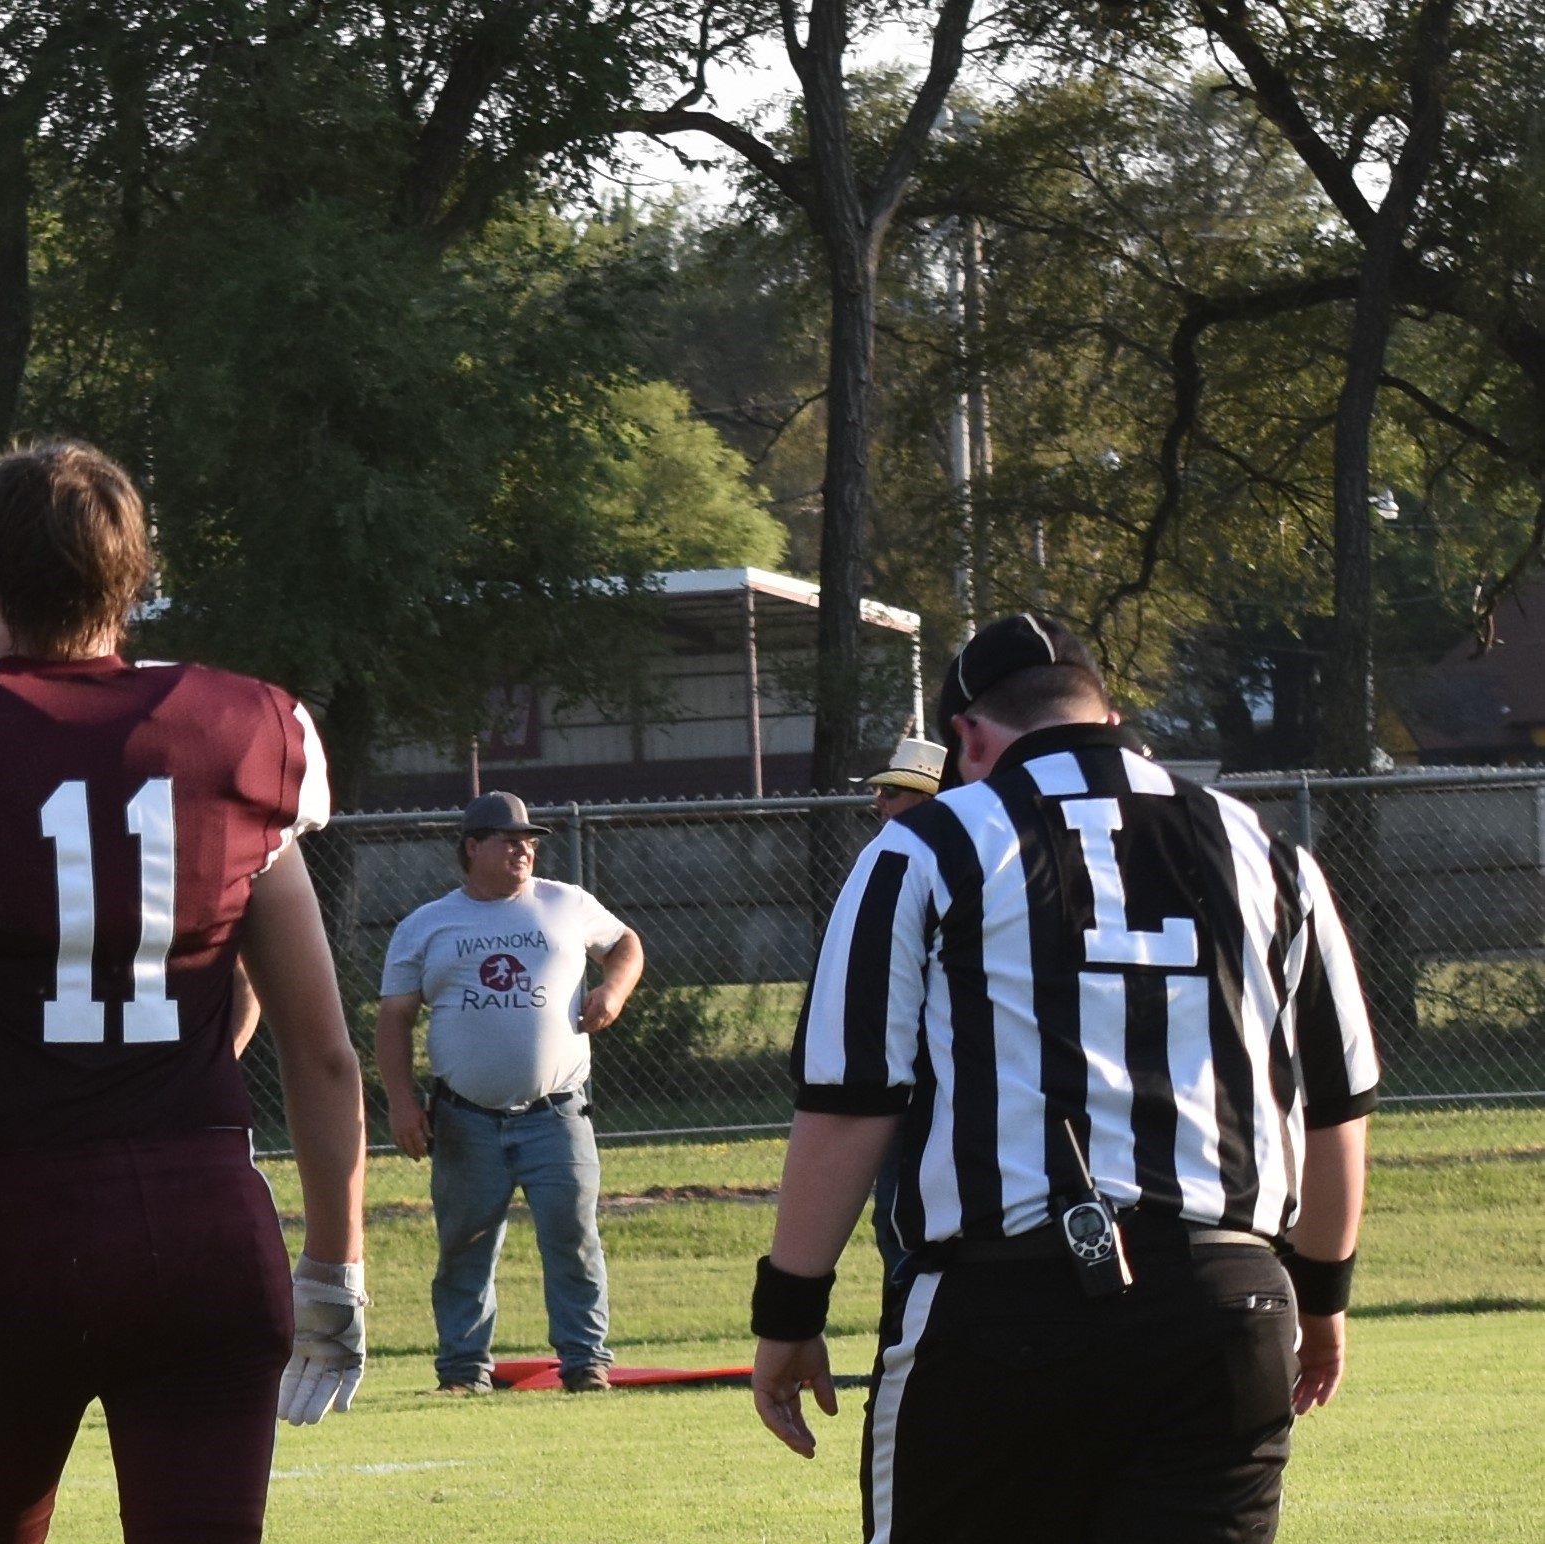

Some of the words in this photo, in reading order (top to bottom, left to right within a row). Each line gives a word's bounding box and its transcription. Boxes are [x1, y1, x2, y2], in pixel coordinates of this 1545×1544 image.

[40, 778, 180, 1043] 11
[1061, 798, 1199, 967] L
[455, 929, 549, 958] WAYNOKA
[461, 985, 547, 1012] RAILS
